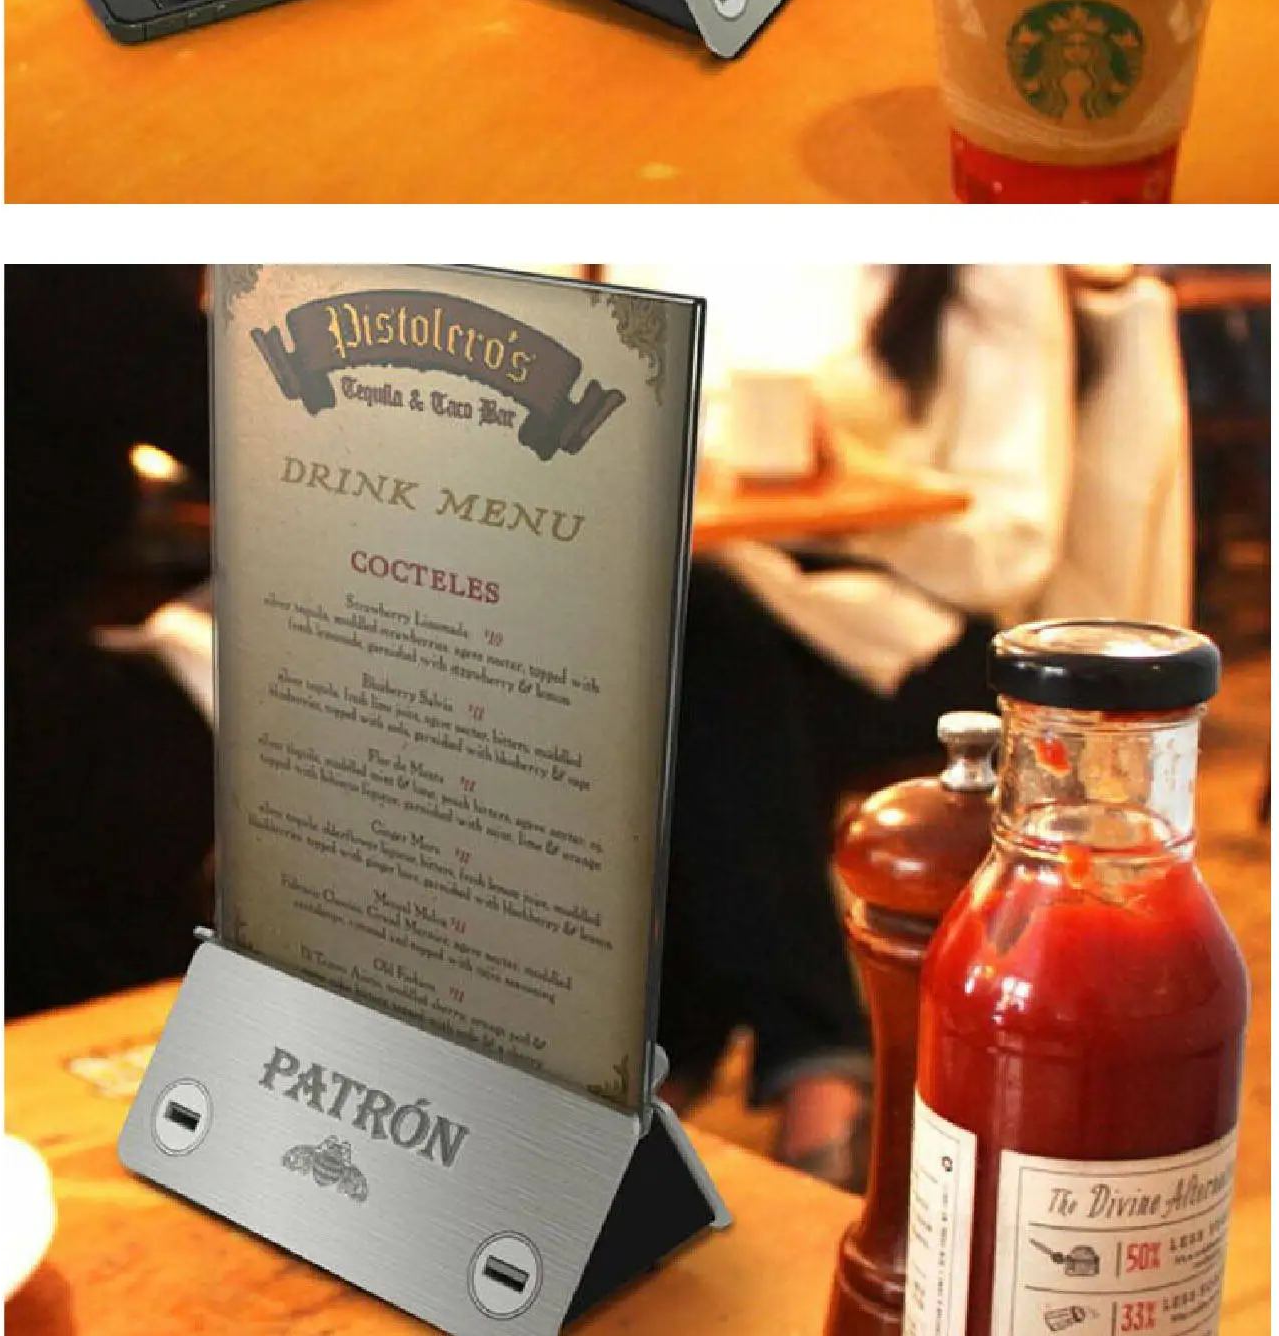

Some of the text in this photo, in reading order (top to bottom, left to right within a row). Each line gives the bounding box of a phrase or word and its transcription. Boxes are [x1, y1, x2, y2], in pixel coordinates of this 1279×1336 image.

[325, 304, 537, 382] Pistolero's
[339, 375, 517, 429] Tequila & Taco Bar
[281, 456, 586, 542] DRINK MENU
[350, 550, 501, 605] COCTELES
[258, 1046, 472, 1168] PATRÓN
[1048, 1183, 1162, 1219] The Divine
[1125, 1241, 1162, 1274] 50%
[1121, 1300, 1158, 1332] 33%
